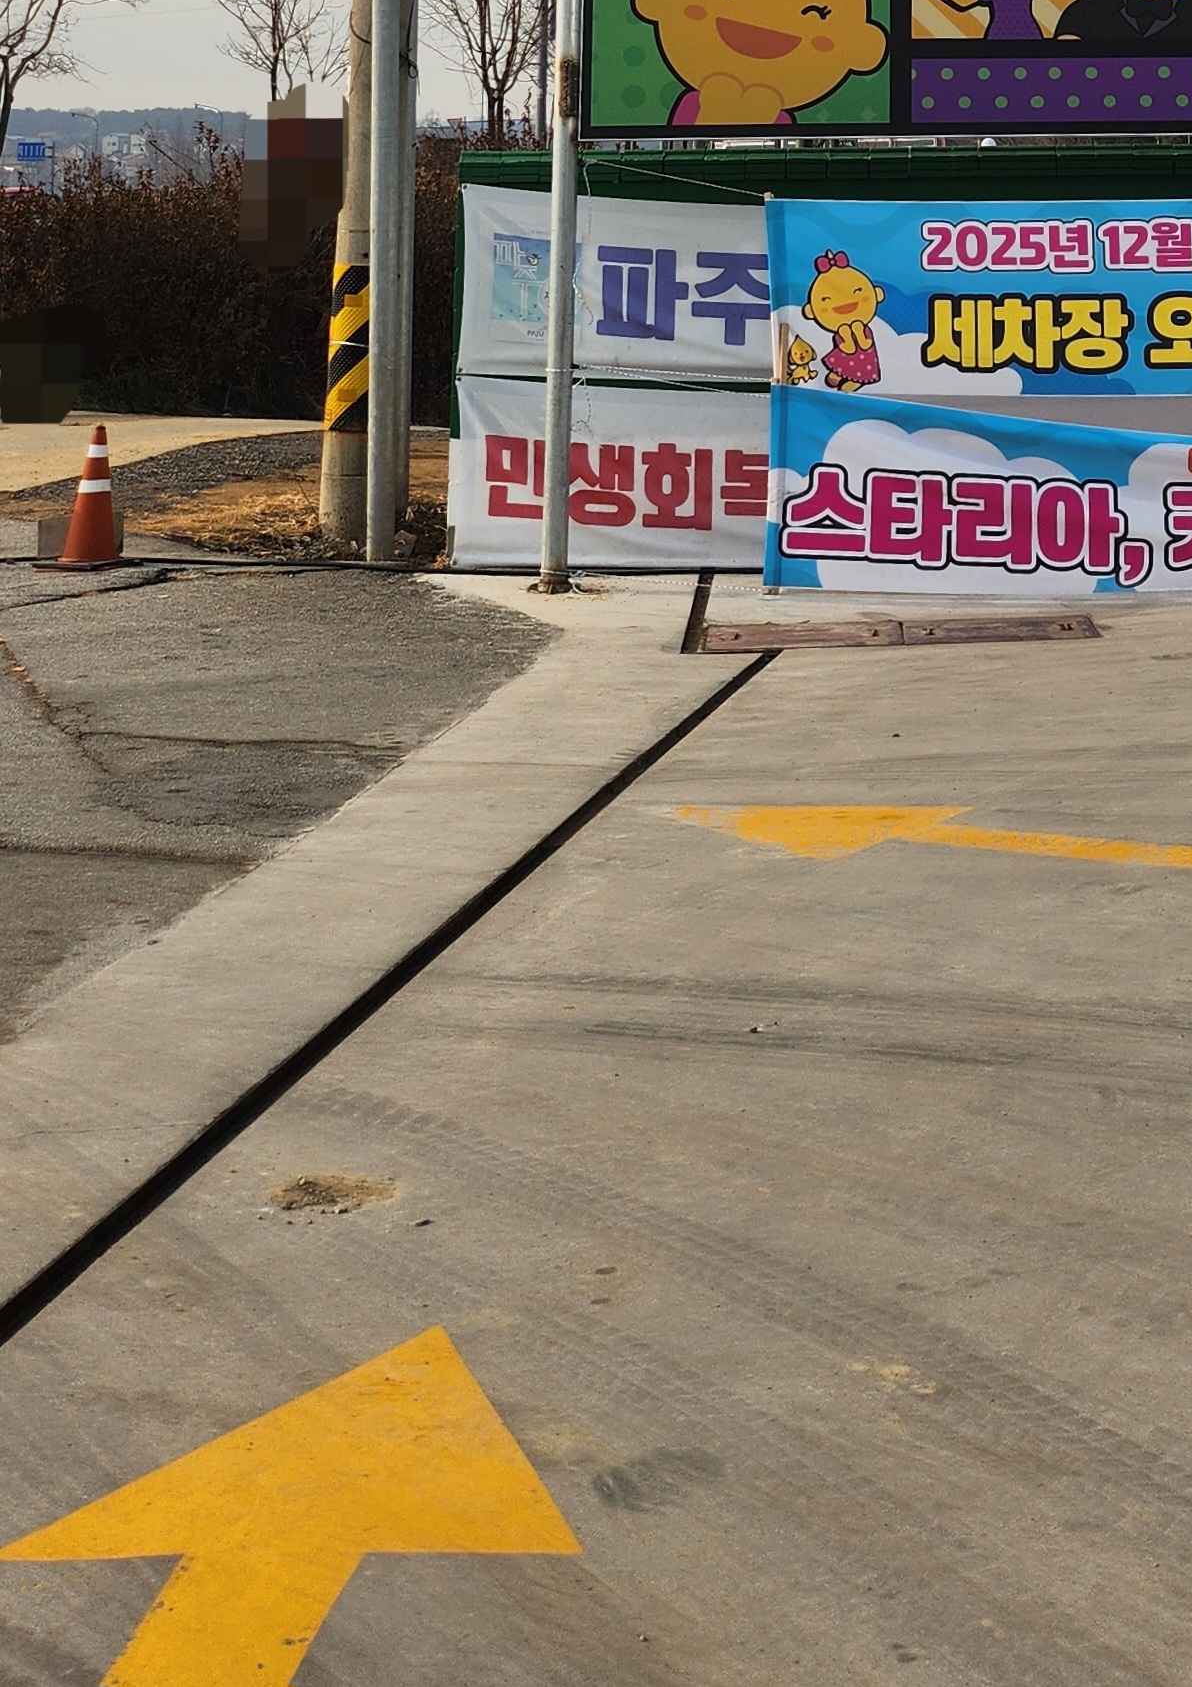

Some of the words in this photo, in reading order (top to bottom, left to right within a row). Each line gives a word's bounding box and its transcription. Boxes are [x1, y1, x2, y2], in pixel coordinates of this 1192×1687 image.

[926, 224, 1091, 268] 2025년
[927, 298, 1128, 369] 세차장
[786, 471, 1148, 582] 스타리아,
